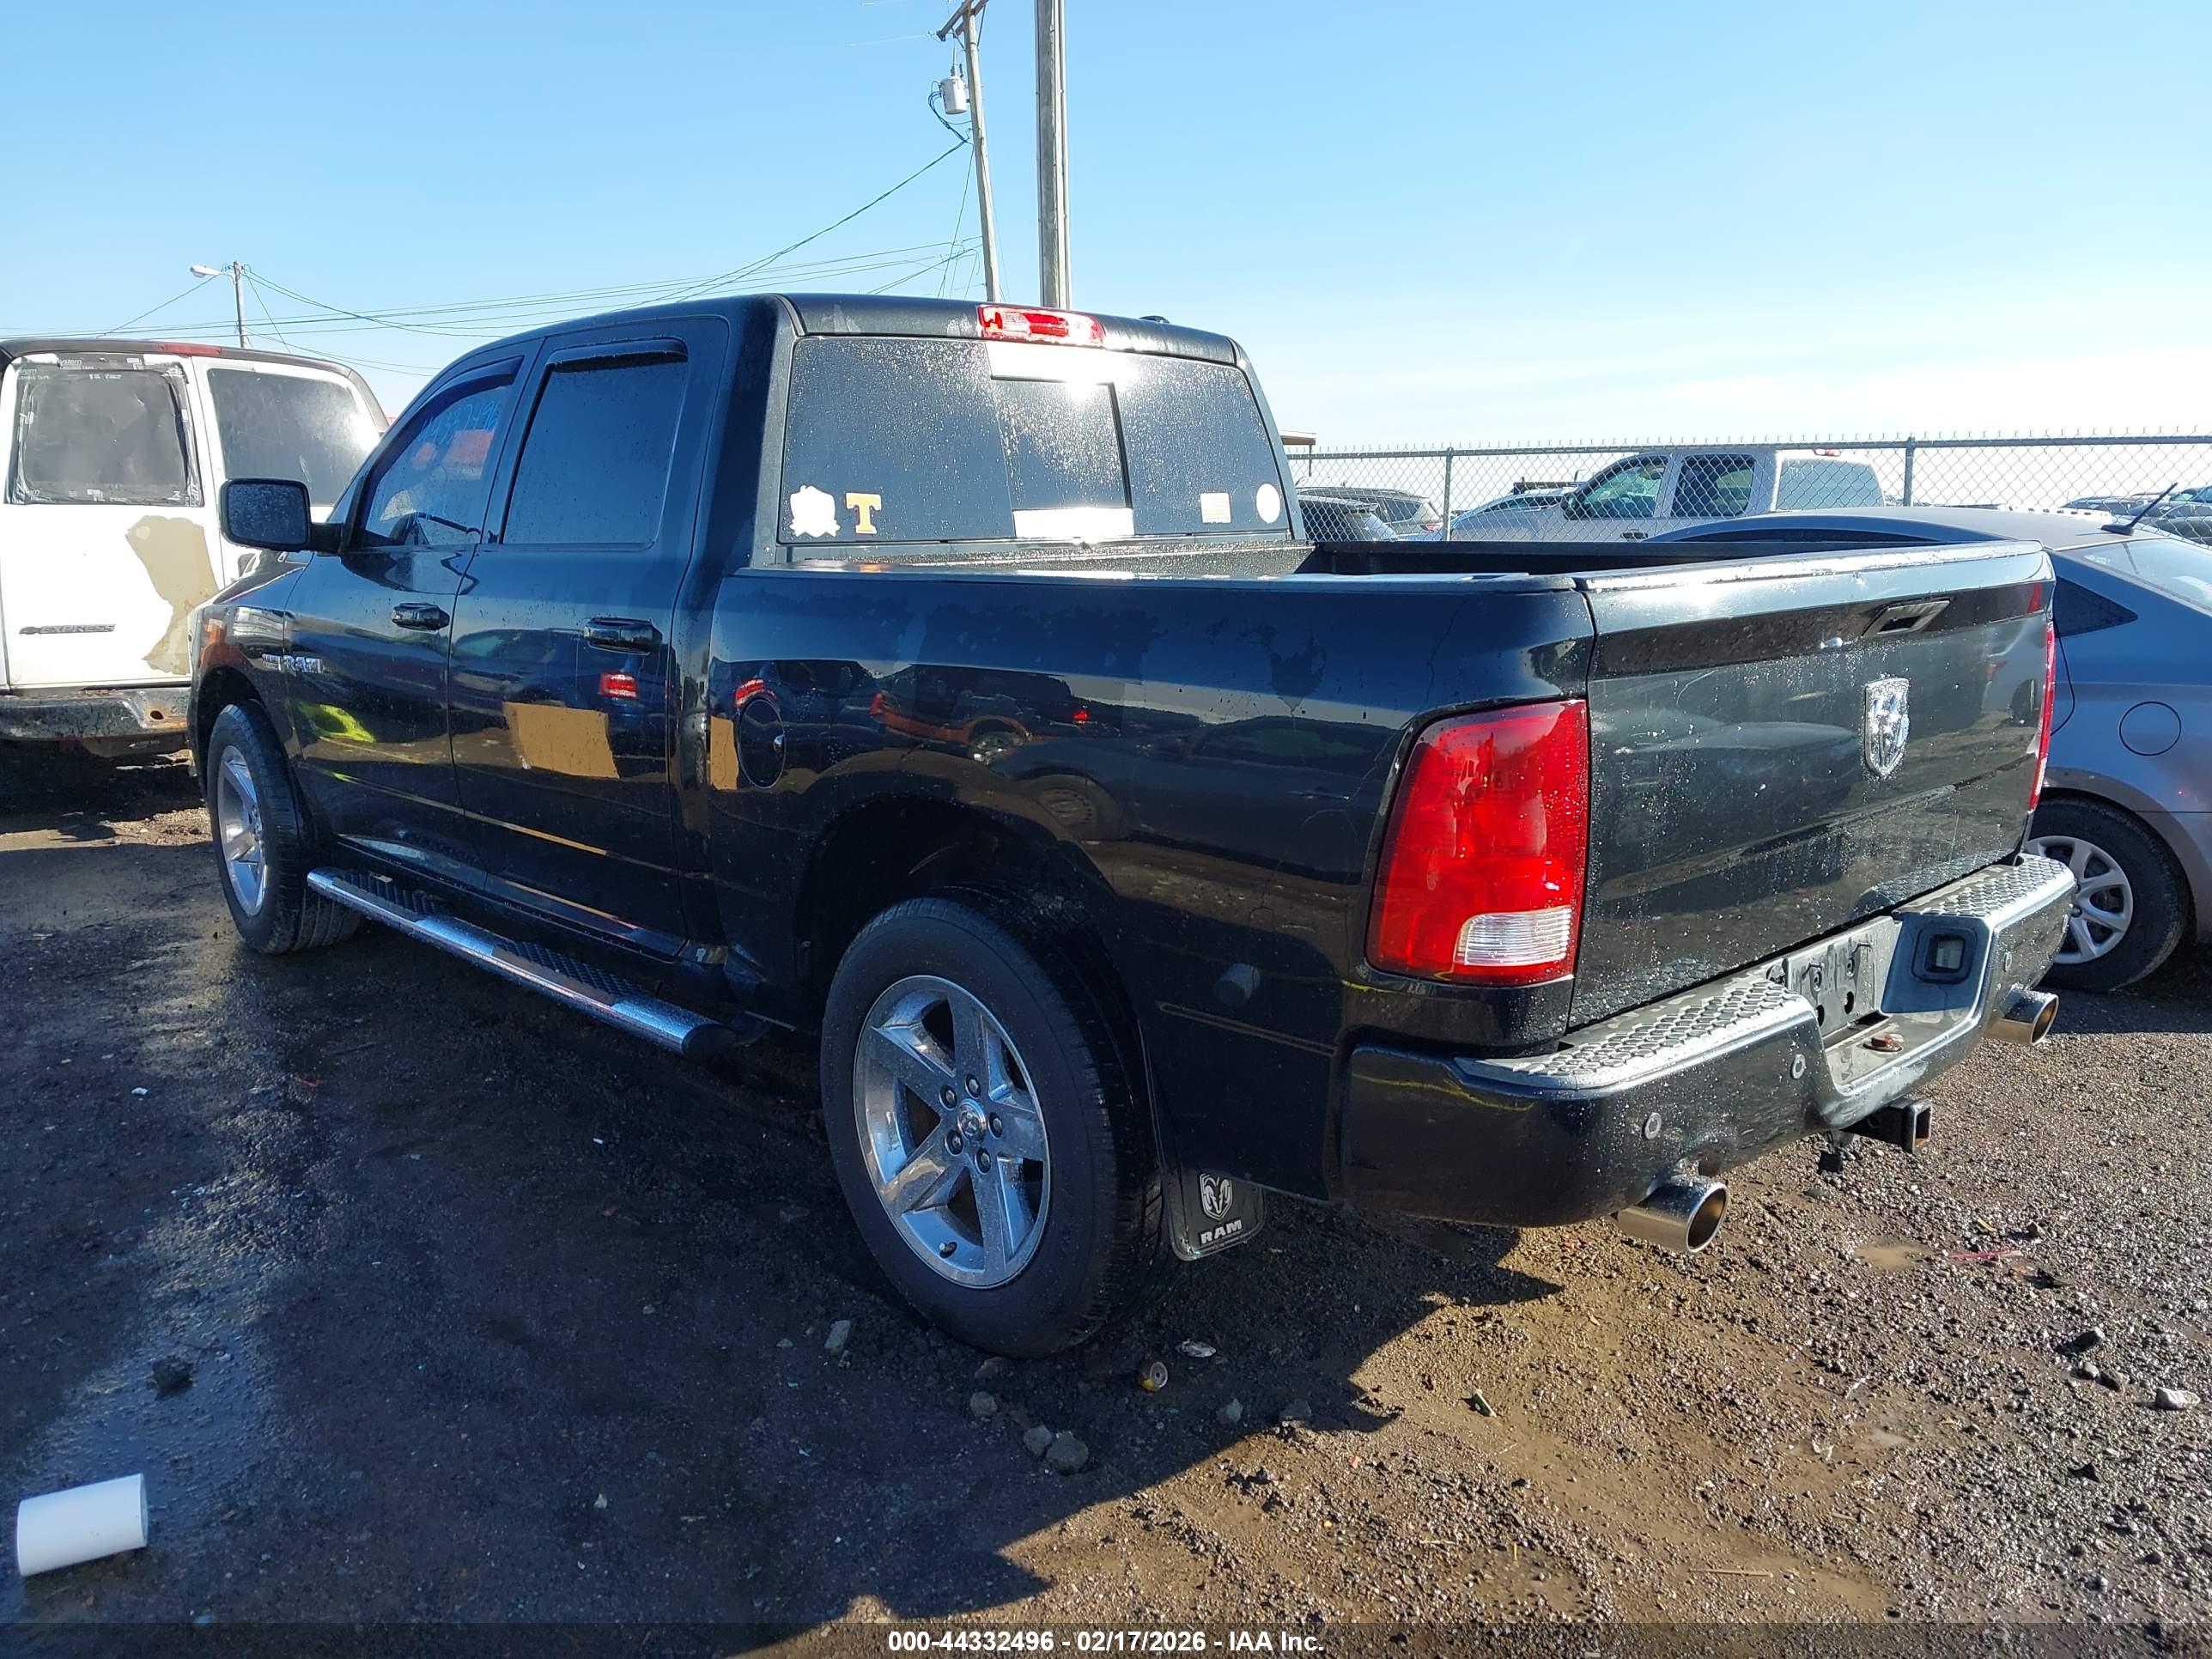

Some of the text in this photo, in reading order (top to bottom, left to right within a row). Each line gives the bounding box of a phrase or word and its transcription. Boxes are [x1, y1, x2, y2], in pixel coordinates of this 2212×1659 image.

[846, 492, 881, 534] T
[40, 624, 115, 634] EXPRESS
[1200, 1219, 1243, 1244] RAM
